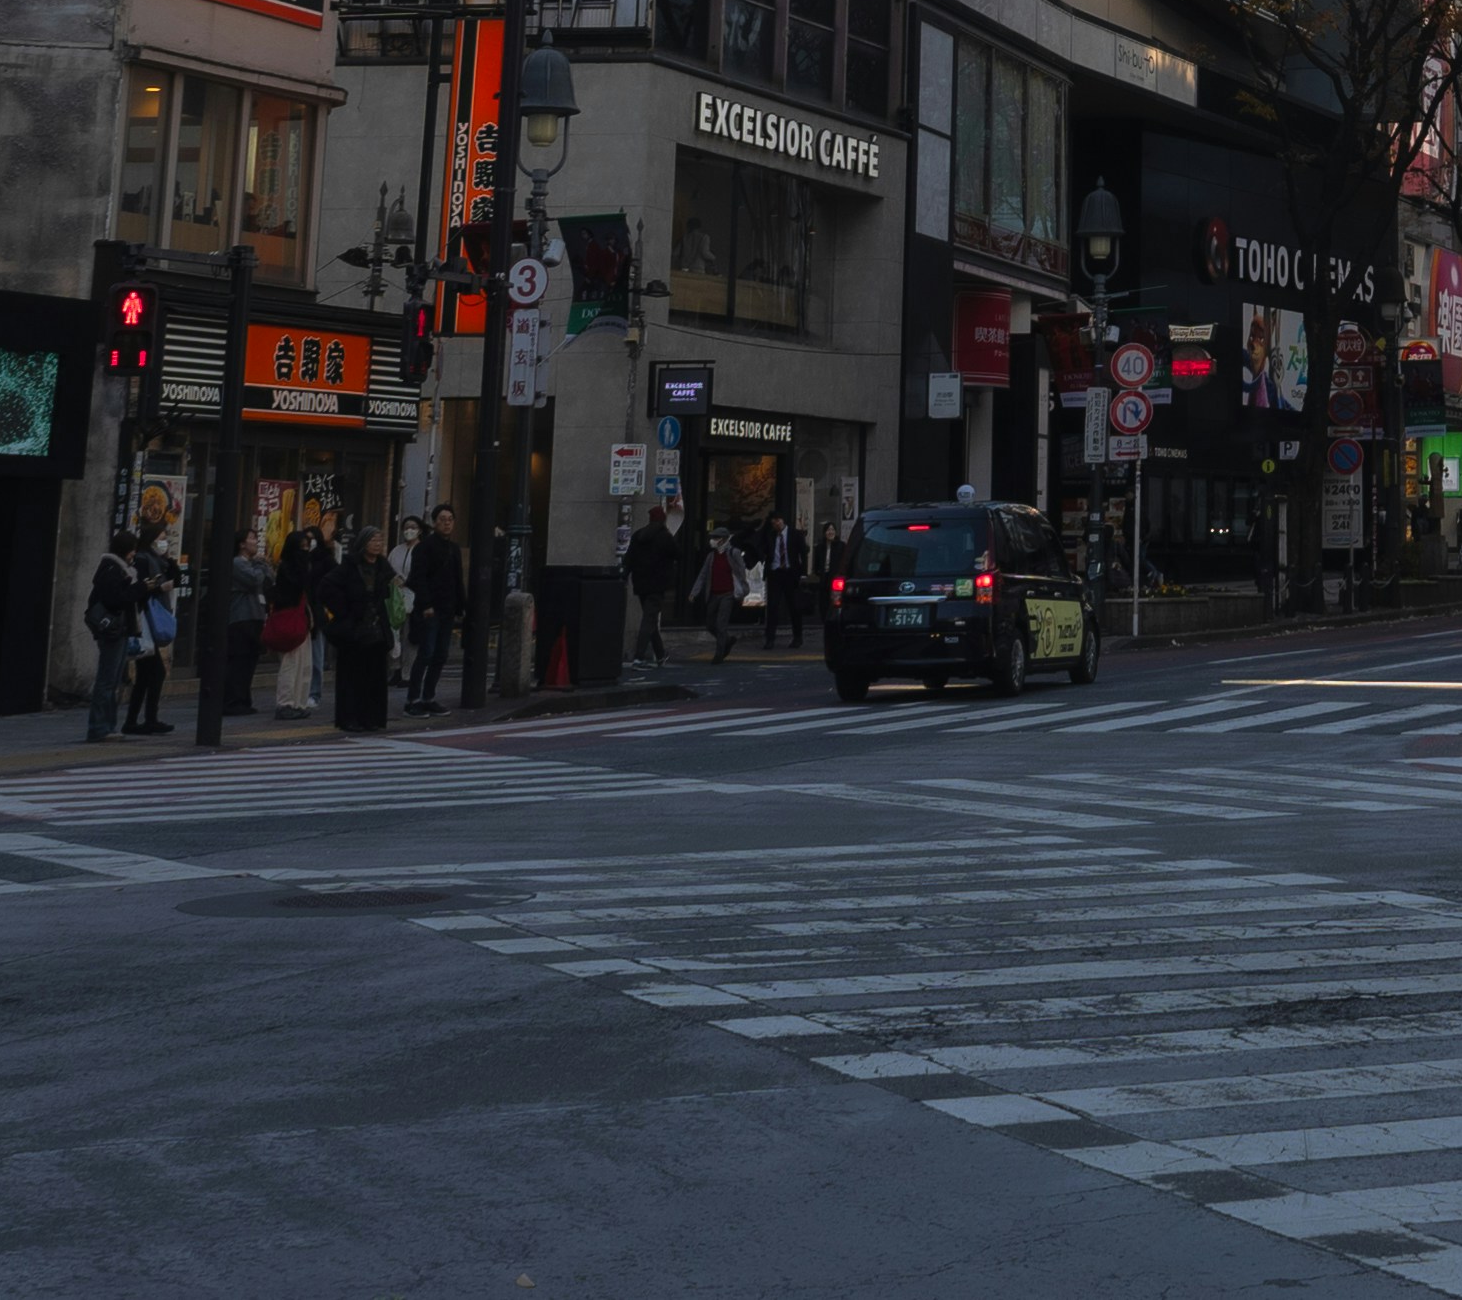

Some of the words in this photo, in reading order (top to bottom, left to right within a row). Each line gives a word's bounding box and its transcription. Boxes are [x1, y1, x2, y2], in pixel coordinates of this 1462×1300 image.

[696, 91, 816, 162] EXCELSIOR
[819, 125, 881, 180] CAFFÉ
[449, 122, 470, 228] YOSHINOYA
[1235, 236, 1289, 288] TOHO
[517, 265, 537, 297] 3
[273, 334, 345, 383] 吉野家
[511, 318, 529, 398] 道玄坂
[1121, 358, 1144, 376] 40
[162, 383, 221, 403] YOSHINOYA
[271, 389, 339, 413] YOSHINOYA
[367, 399, 418, 418] YOSHINOYA
[710, 417, 761, 439] EXCELSIOR
[763, 421, 793, 442] CAFFÉ
[305, 473, 337, 495] 大きくて
